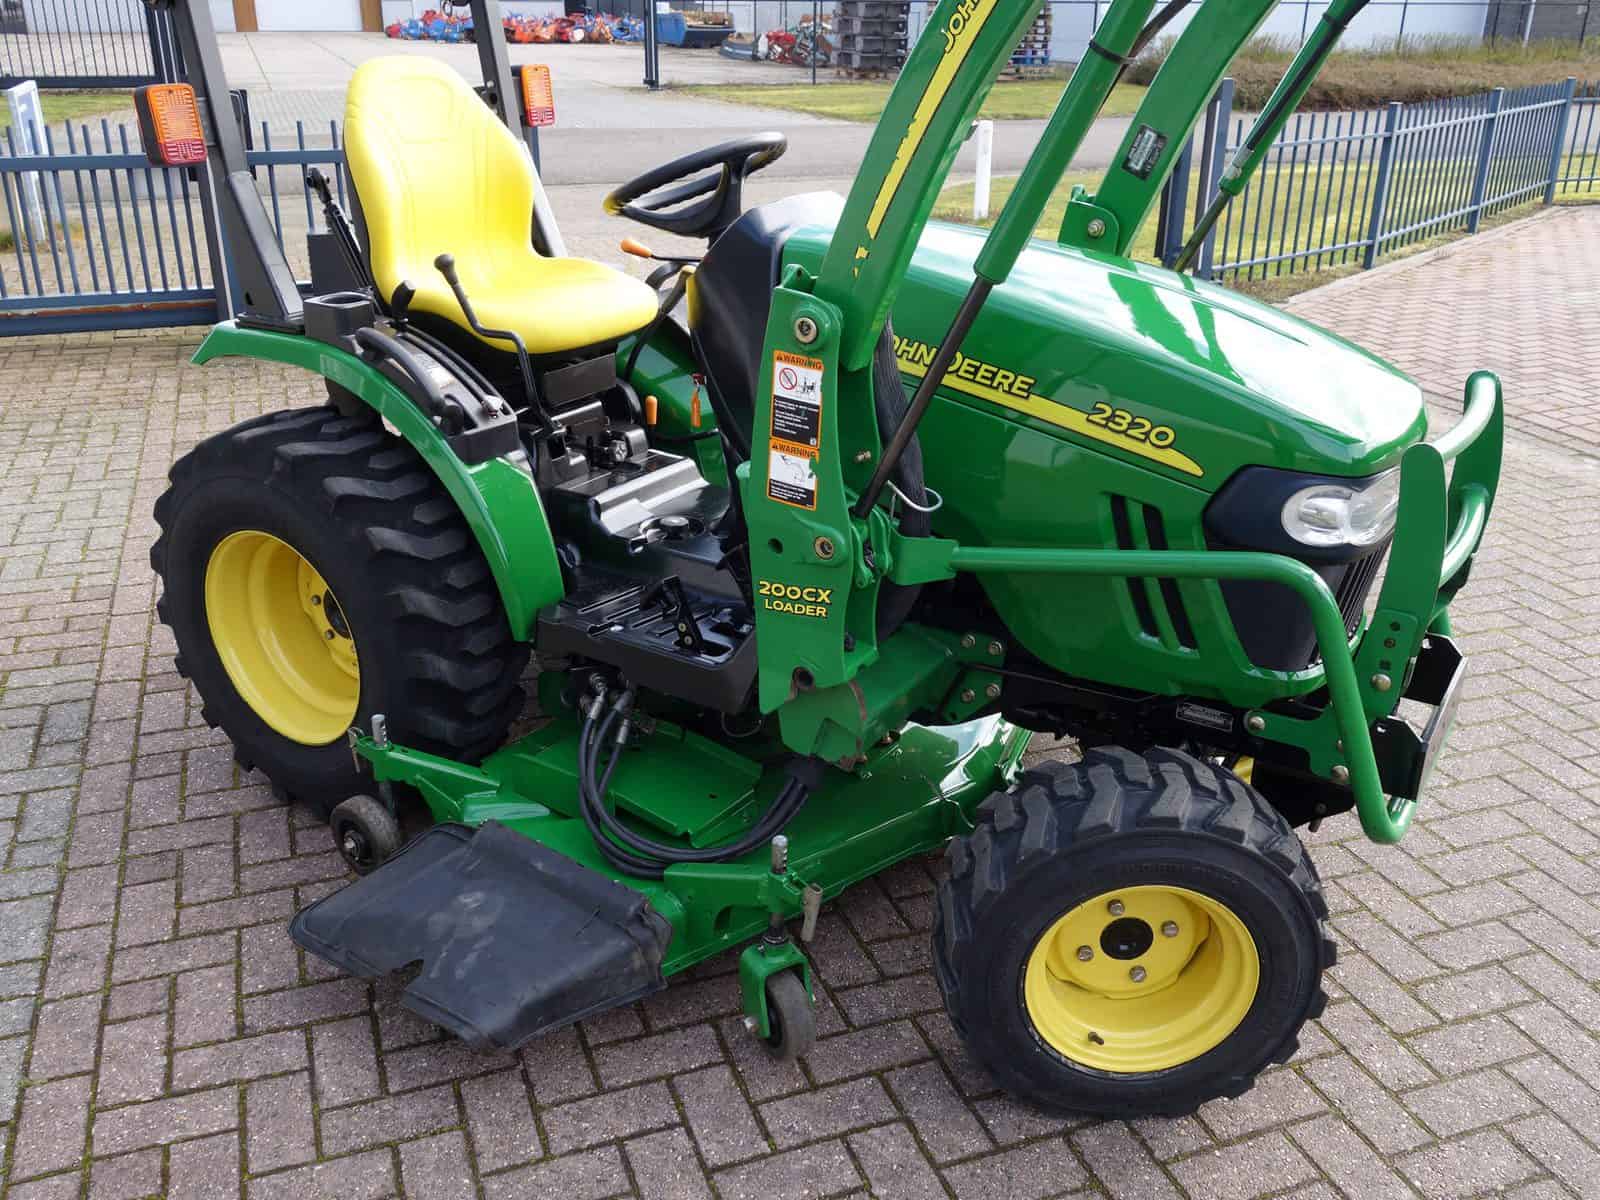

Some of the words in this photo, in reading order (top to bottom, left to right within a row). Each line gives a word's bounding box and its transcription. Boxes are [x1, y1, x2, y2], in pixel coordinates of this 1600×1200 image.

[942, 0, 979, 53] JOH
[783, 354, 823, 371] WARNING
[893, 334, 937, 367] HN
[1087, 402, 1176, 448] 2320
[779, 443, 817, 459] WARNING
[759, 580, 832, 604] 200CX
[764, 598, 827, 617] LOADER
